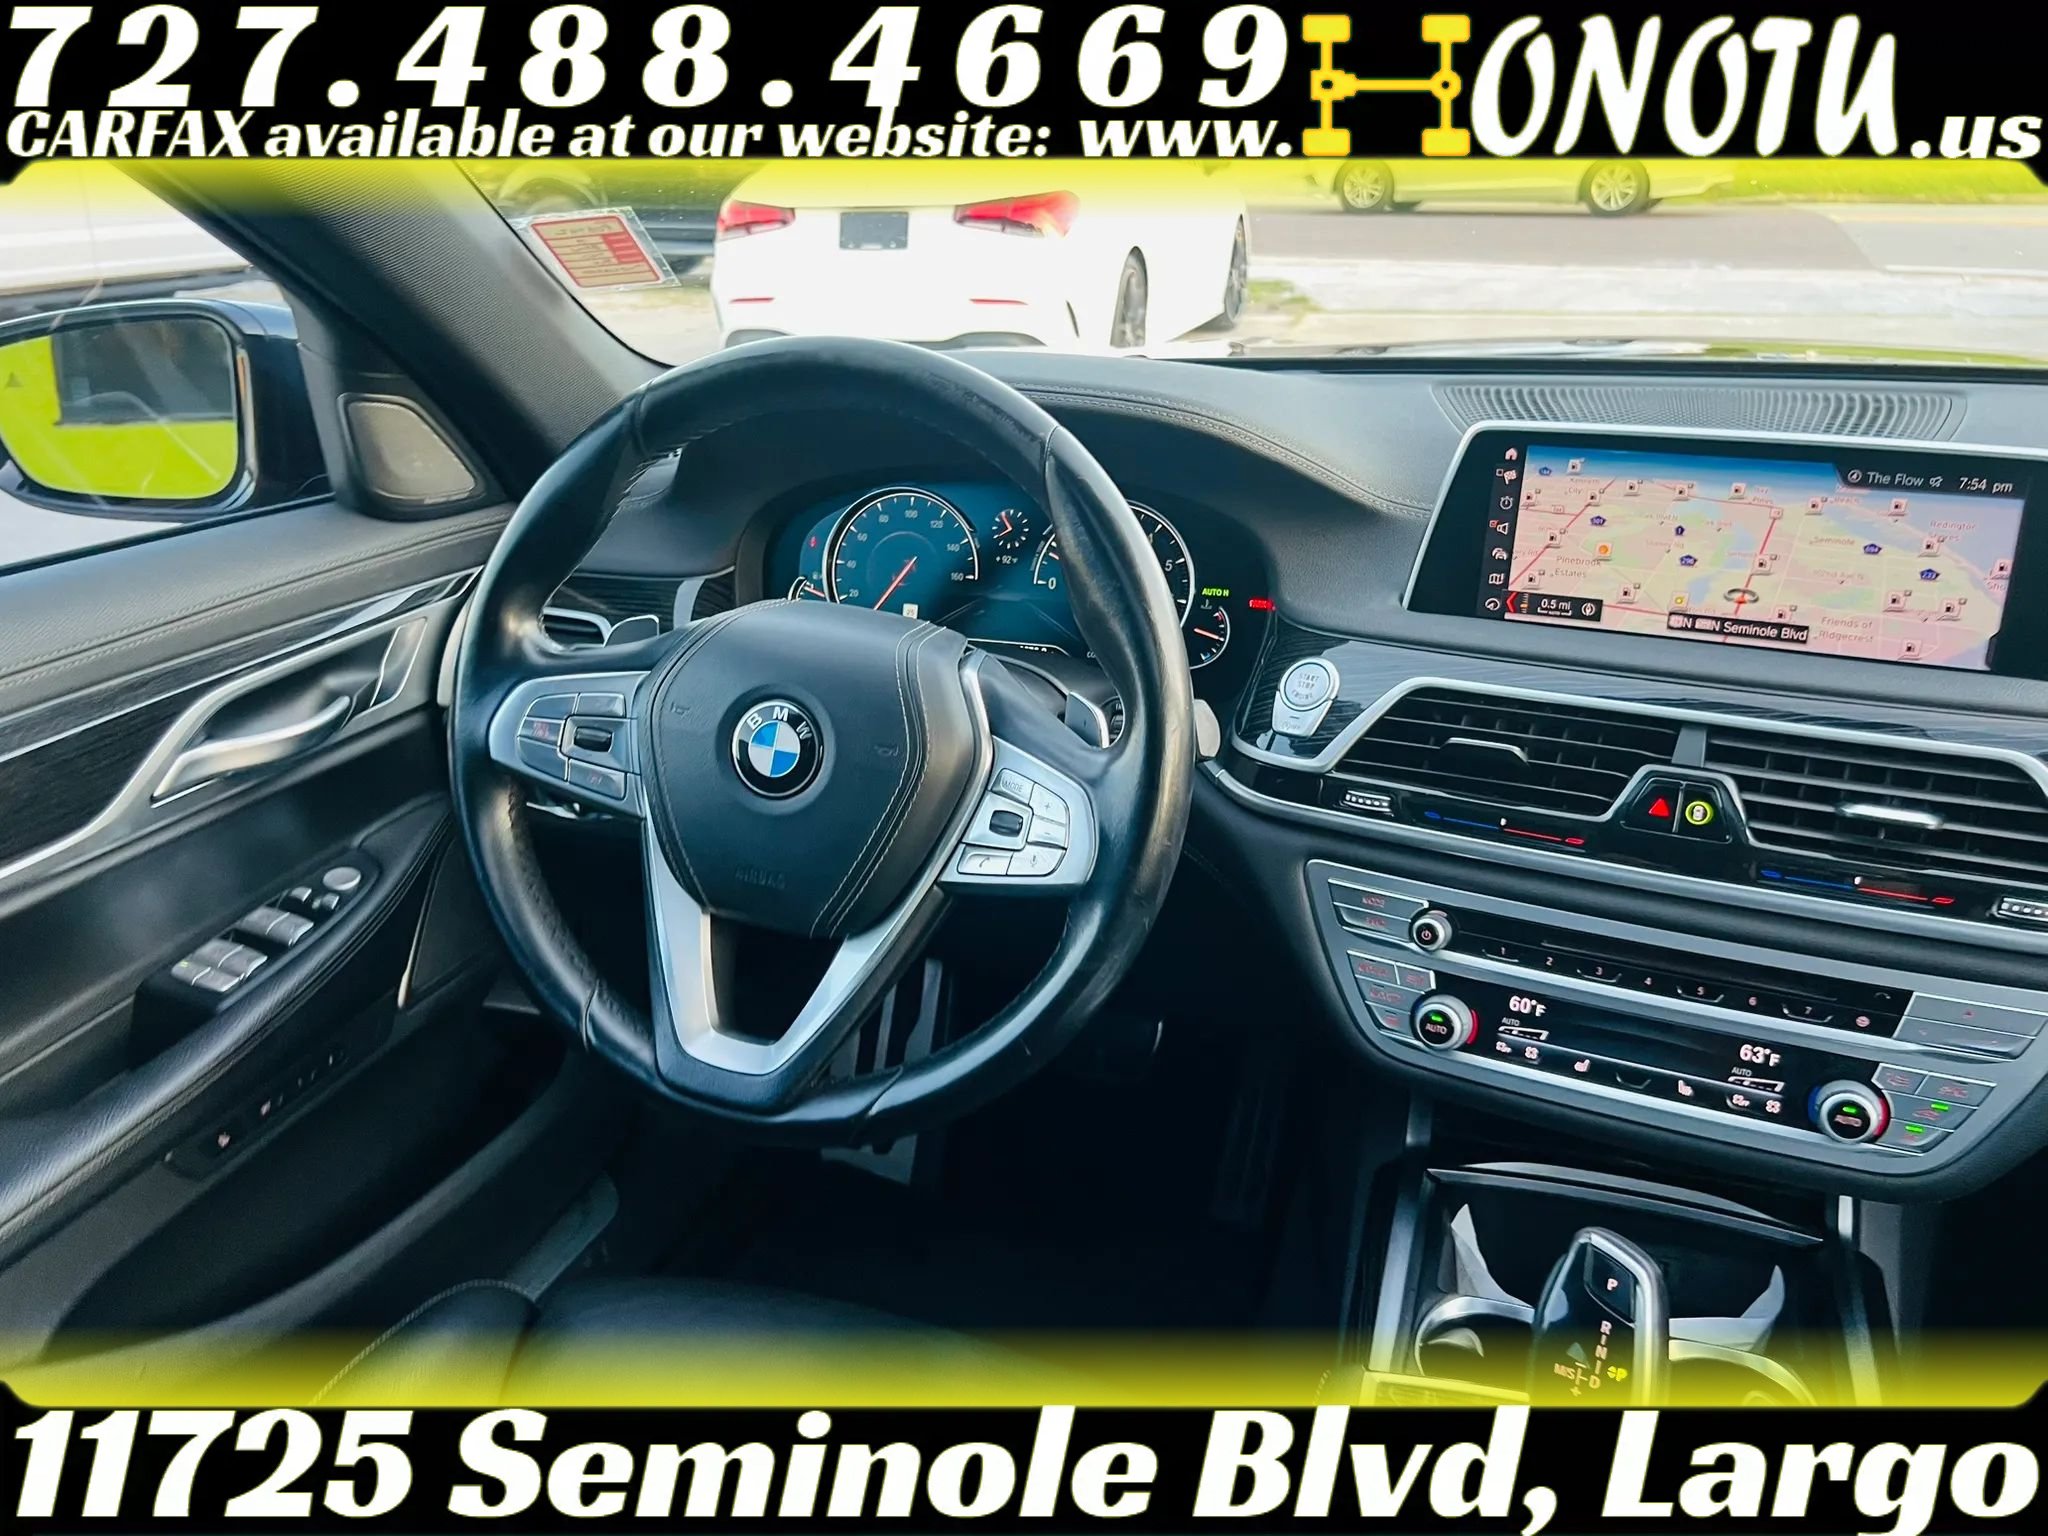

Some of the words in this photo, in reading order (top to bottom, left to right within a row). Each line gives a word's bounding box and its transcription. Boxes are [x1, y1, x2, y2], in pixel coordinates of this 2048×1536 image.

[1867, 471, 1891, 485] The
[1895, 473, 1925, 487] Flow
[1959, 477, 1987, 491] 7:54
[1992, 481, 2014, 494] pm
[1164, 559, 1173, 572] 5
[1048, 577, 1057, 590] 0
[849, 589, 859, 597] 20
[1201, 588, 1221, 597] AUTO
[1223, 589, 1230, 597] H
[1541, 598, 1557, 609] 0.5
[1558, 601, 1571, 610] mi
[1821, 616, 1859, 628] Friends
[1862, 620, 1873, 628] of
[1723, 621, 1778, 638] Seminole
[1780, 627, 1808, 641] Blvd
[747, 706, 813, 740] BMW
[1501, 1017, 1520, 1027] AUTO
[1425, 1023, 1448, 1035] AUTO
[1732, 1066, 1752, 1077] AUTO
[1606, 1277, 1619, 1291] P
[1600, 1320, 1613, 1336] R
[1595, 1344, 1608, 1361] N
[1588, 1374, 1601, 1390] D
